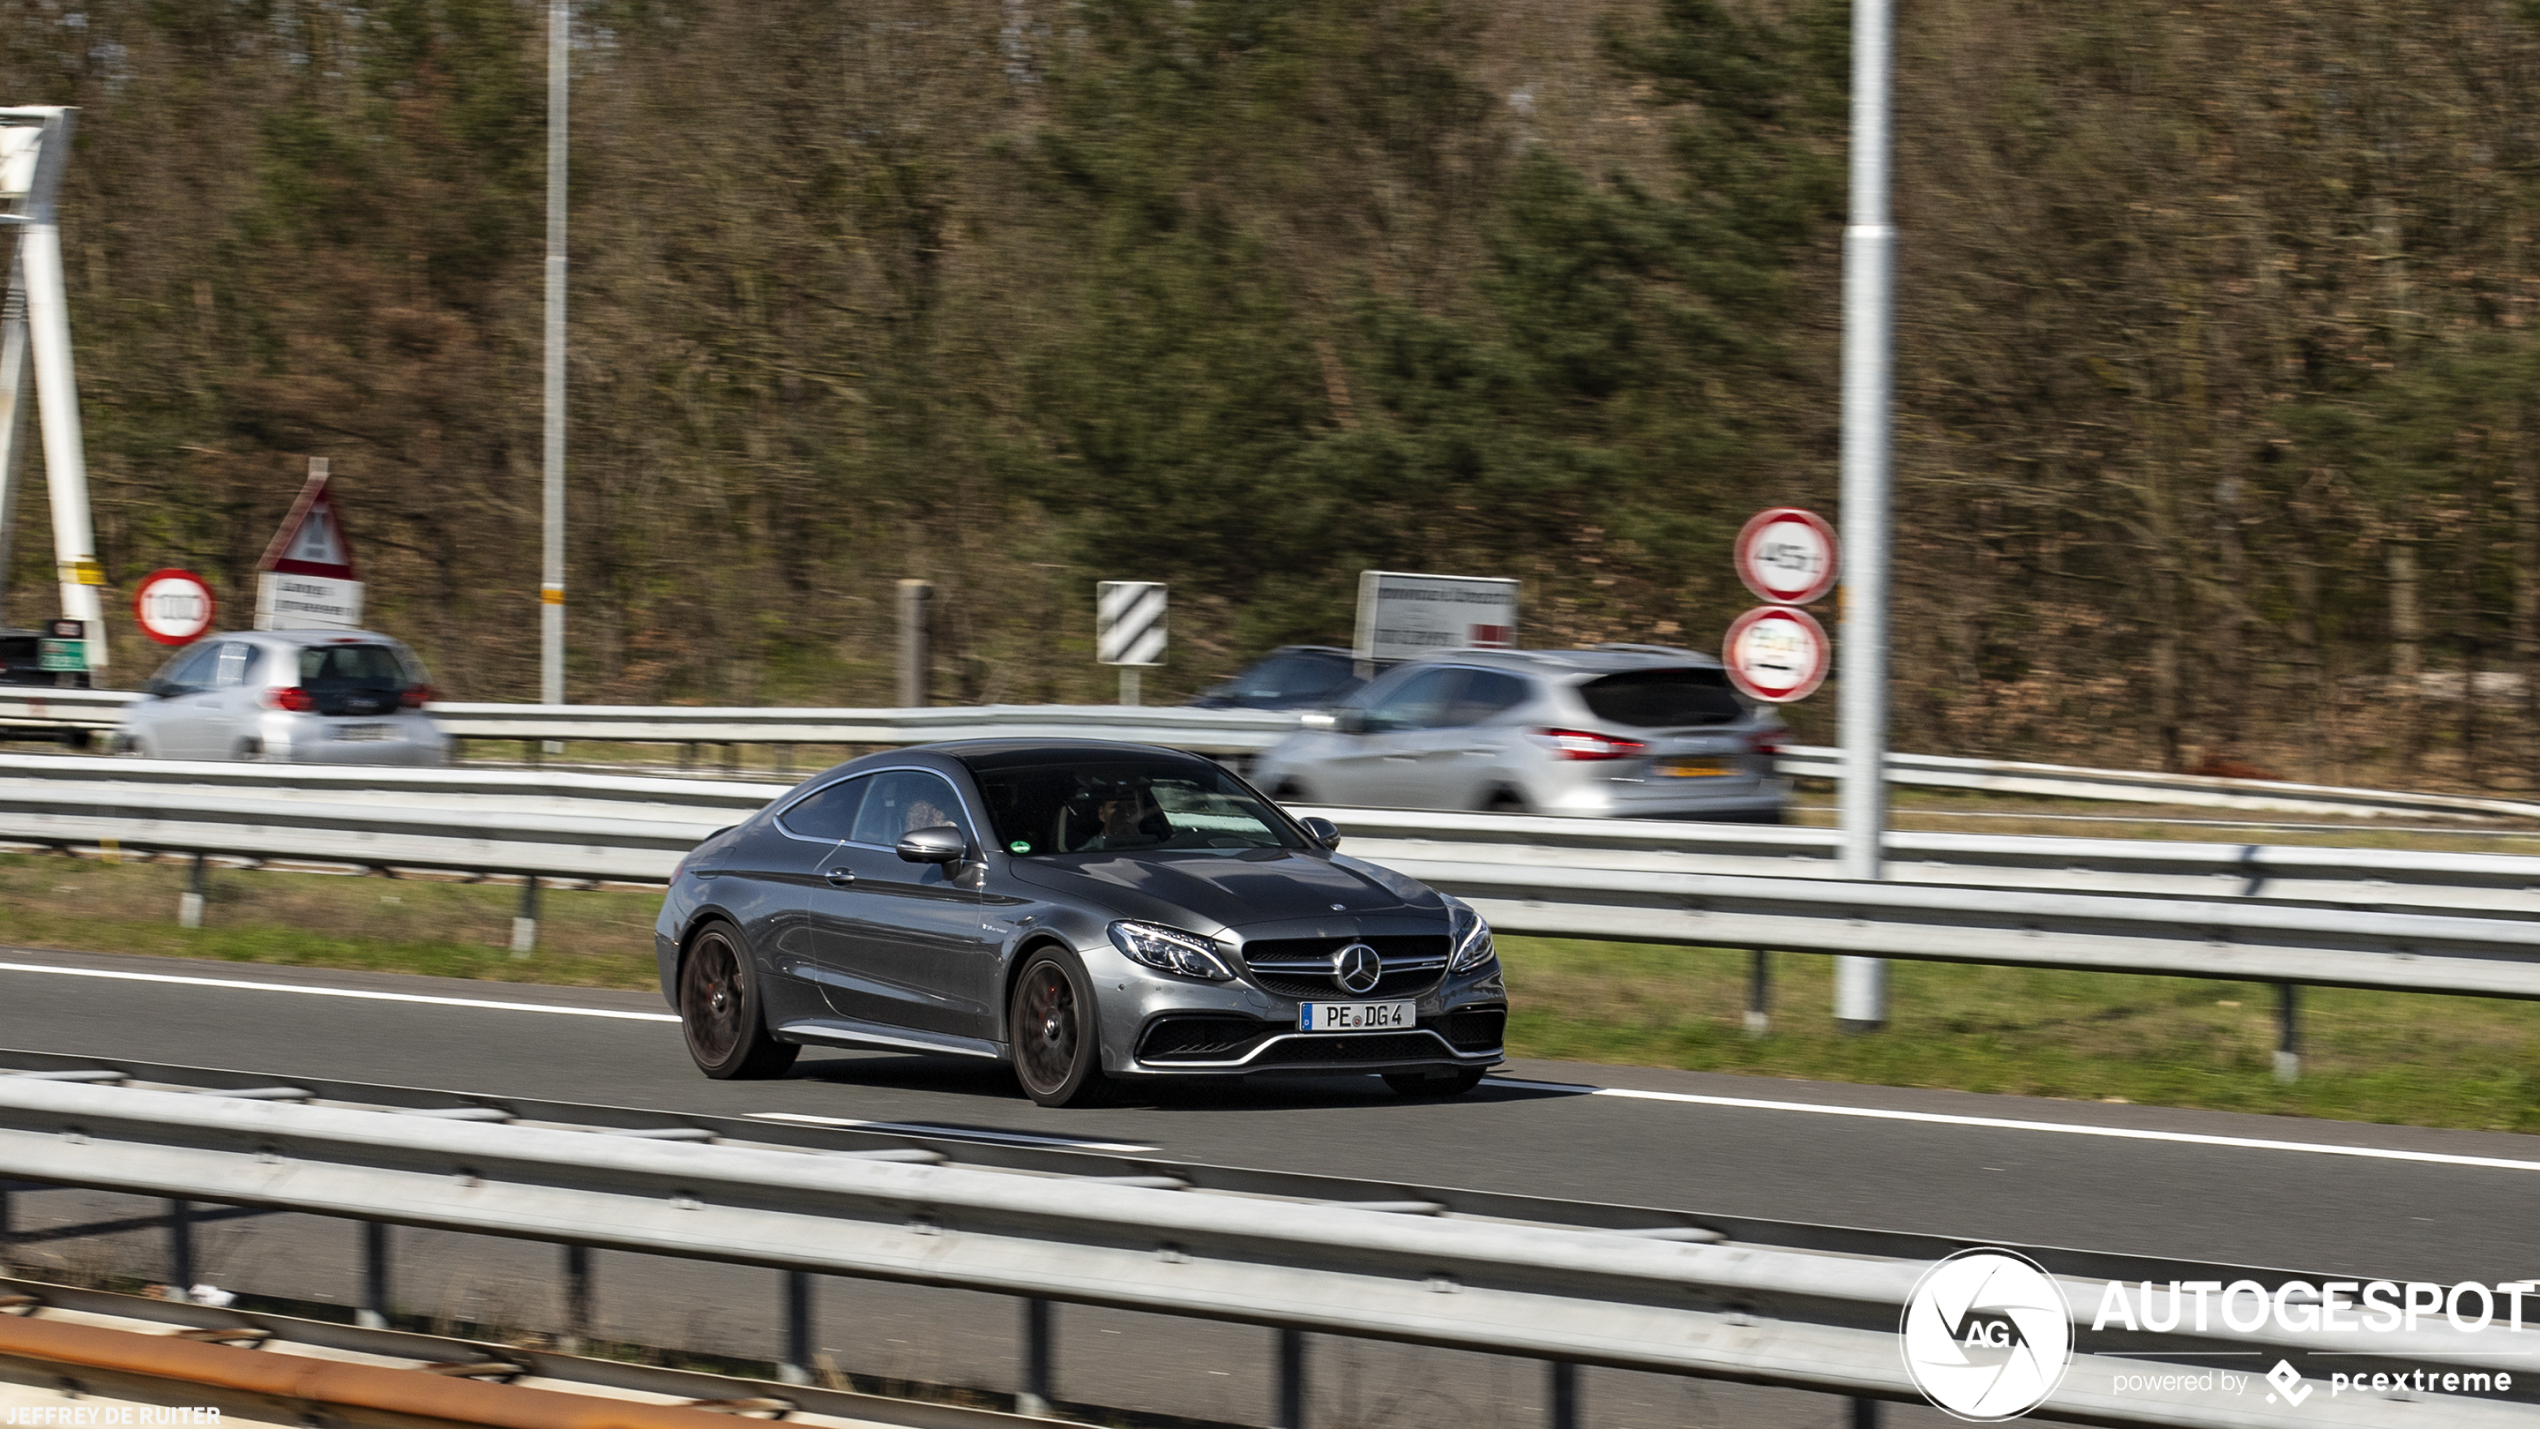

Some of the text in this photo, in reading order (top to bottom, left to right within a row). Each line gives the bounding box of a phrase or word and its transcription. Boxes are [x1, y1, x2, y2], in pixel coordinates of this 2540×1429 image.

[1326, 1004, 1402, 1027] PE DG 4
